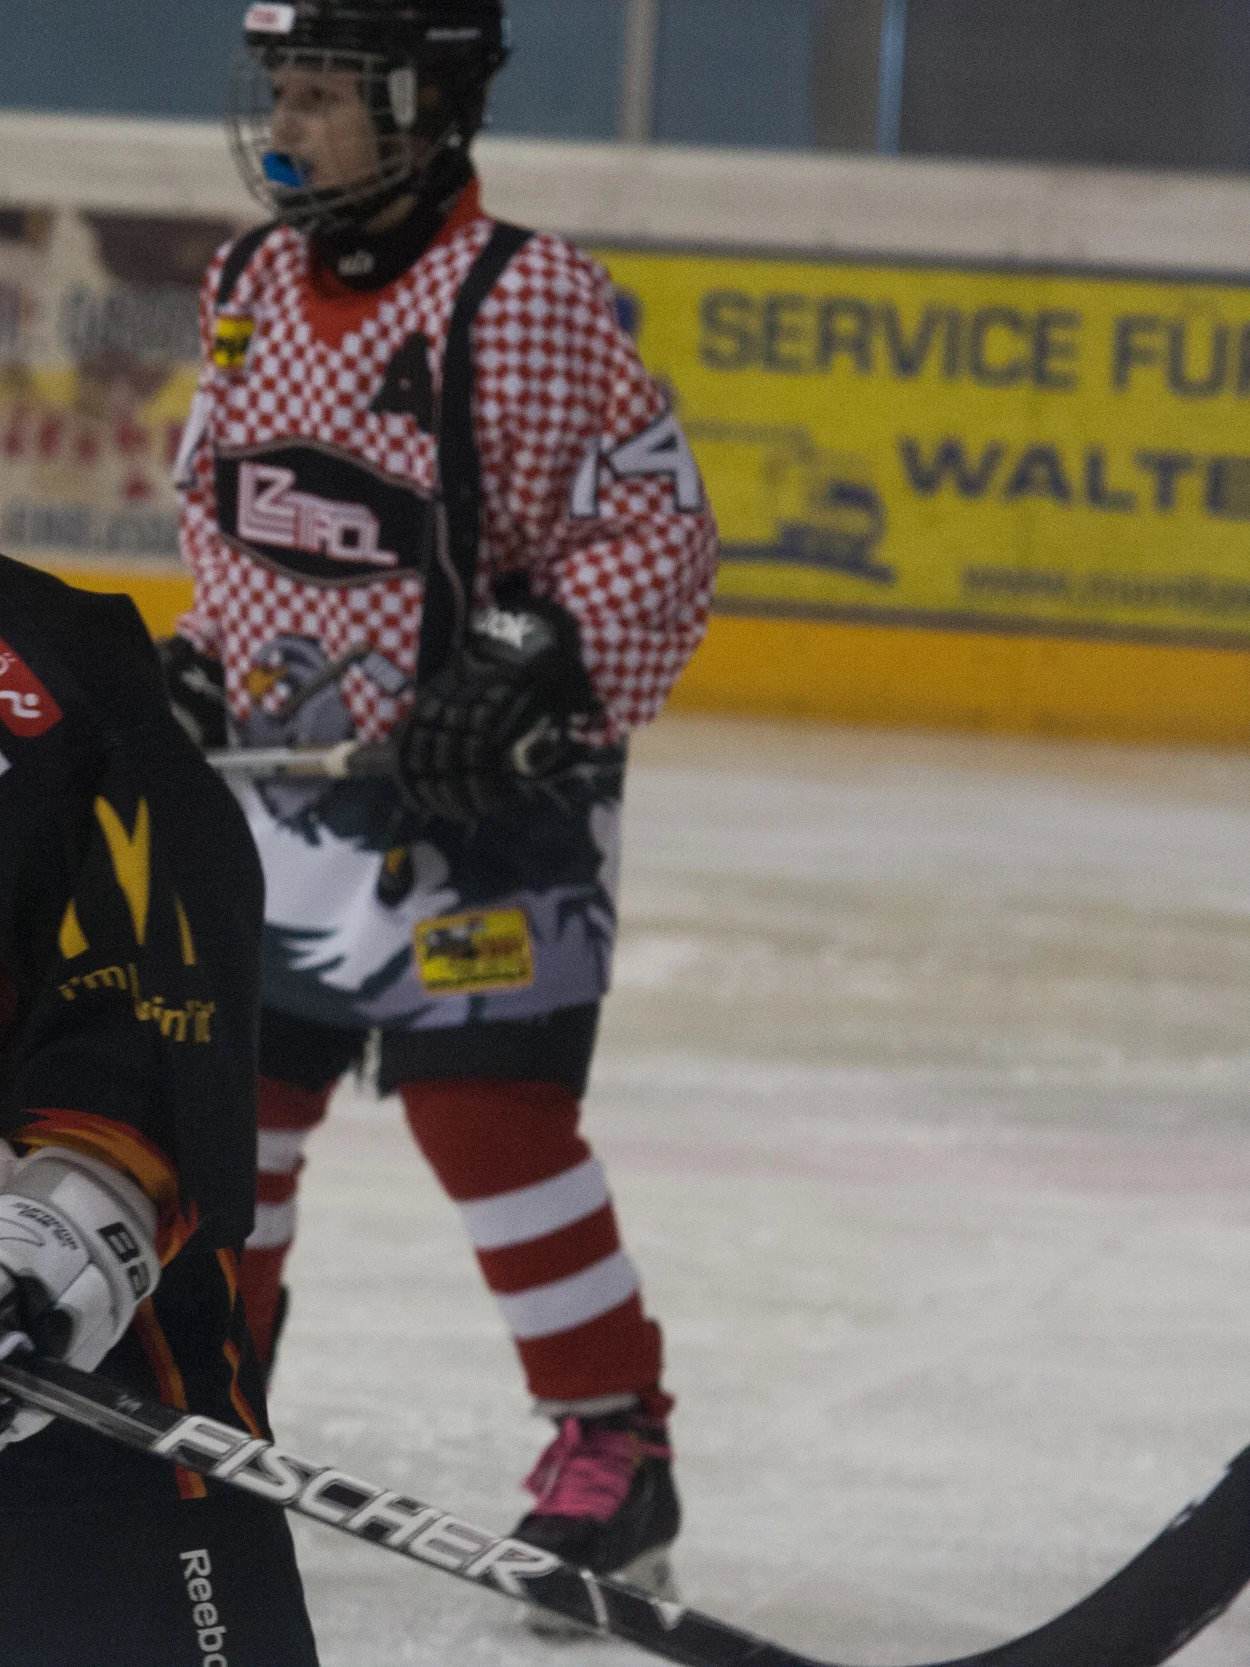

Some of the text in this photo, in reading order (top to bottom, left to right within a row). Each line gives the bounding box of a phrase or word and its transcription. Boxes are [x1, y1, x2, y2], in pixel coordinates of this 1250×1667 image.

[700, 289, 1082, 393] SERVICE
[900, 435, 1250, 520] WALTE
[153, 1413, 562, 1596] FISCHER
[179, 1548, 227, 1667] Reebo
